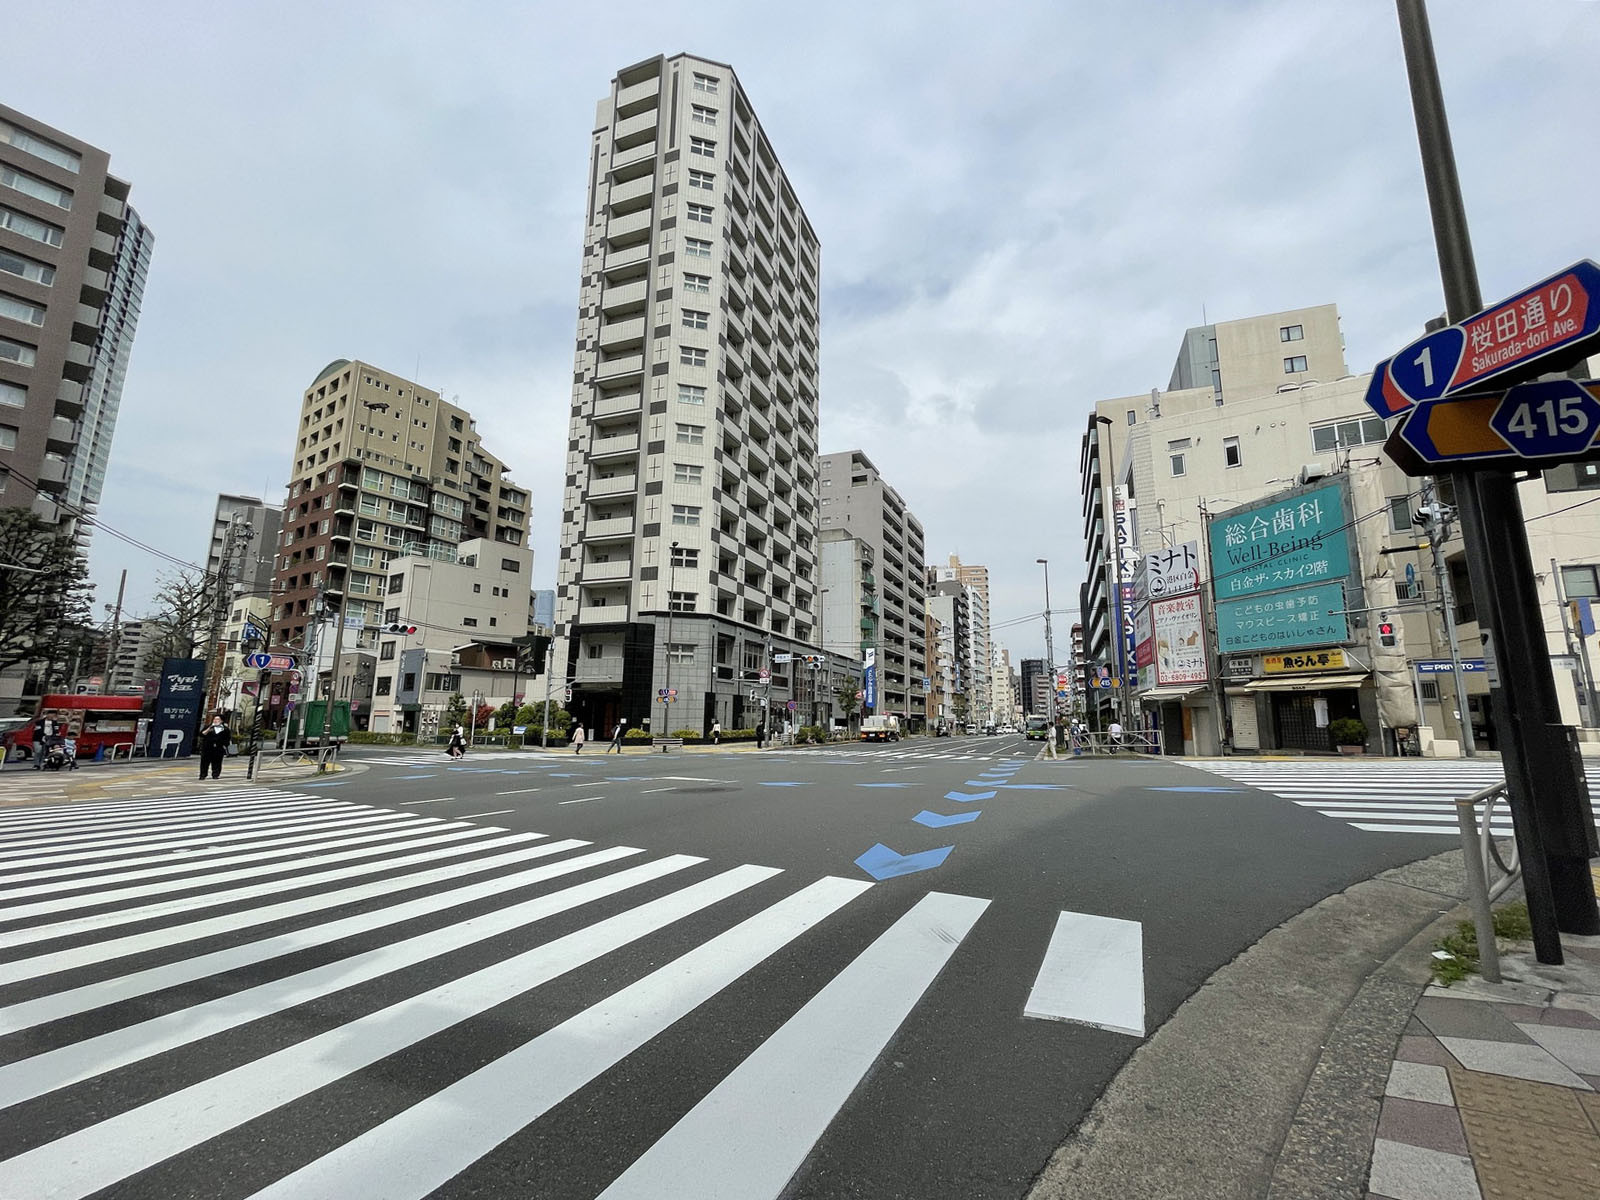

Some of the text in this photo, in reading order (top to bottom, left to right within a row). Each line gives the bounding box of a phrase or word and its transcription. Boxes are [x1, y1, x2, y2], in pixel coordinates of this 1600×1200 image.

[1471, 283, 1572, 354] 桜田通り
[1471, 316, 1578, 372] Sakurada-dori Ave.
[1413, 347, 1434, 387] 1
[1507, 397, 1588, 438] 415
[1225, 499, 1324, 547] 総合歯科
[1149, 545, 1196, 575] ミナト
[1227, 531, 1323, 566] Well-Being
[1279, 554, 1310, 566] CLINIC
[1235, 595, 1319, 617] こどもの虫歯予防
[260, 656, 265, 665] 1
[161, 729, 185, 750] P
